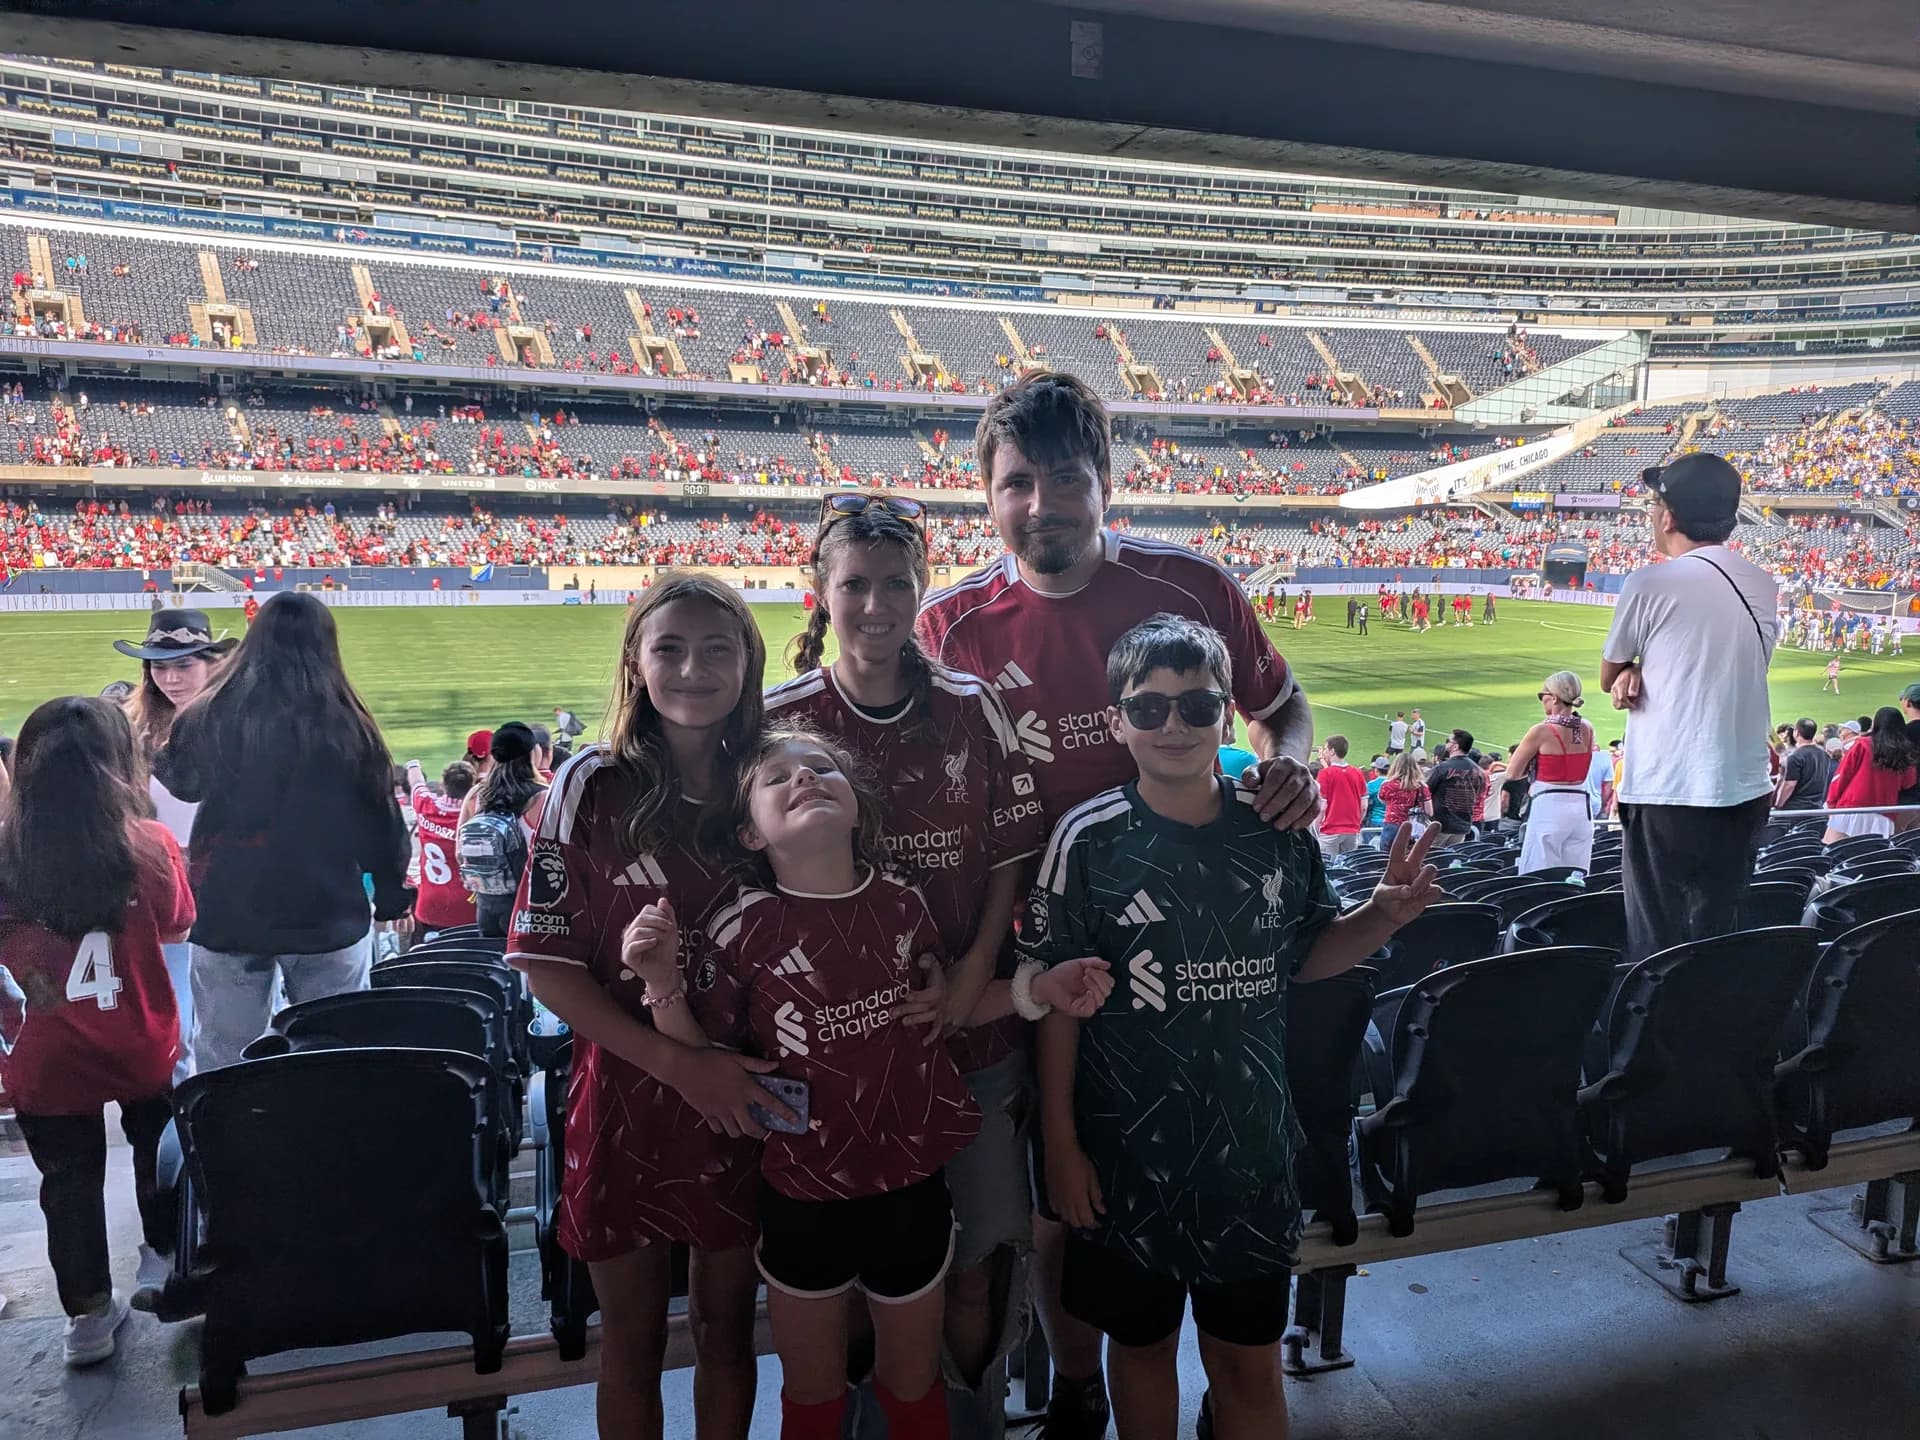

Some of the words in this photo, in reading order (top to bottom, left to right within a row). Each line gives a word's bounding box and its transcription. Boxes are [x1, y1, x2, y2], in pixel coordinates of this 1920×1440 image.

[1519, 448, 1549, 467] CHICAGO
[201, 472, 227, 484] BLUE
[294, 476, 344, 486] Advocate
[441, 480, 484, 488] UNITED
[538, 481, 560, 490] PNC
[738, 486, 785, 497] SOLDIER
[791, 487, 821, 497] FIELD
[1122, 495, 1174, 505] ticketmaster
[7, 594, 74, 610] IVERPOOL
[1058, 710, 1107, 732] stan
[992, 800, 1044, 827] Expe
[883, 827, 962, 850] andard
[424, 842, 452, 885] 8
[65, 931, 123, 1012] 4
[1174, 951, 1276, 981] standard
[1176, 971, 1278, 1002] chartered
[815, 978, 911, 1025] standard
[817, 1009, 890, 1042] charte
